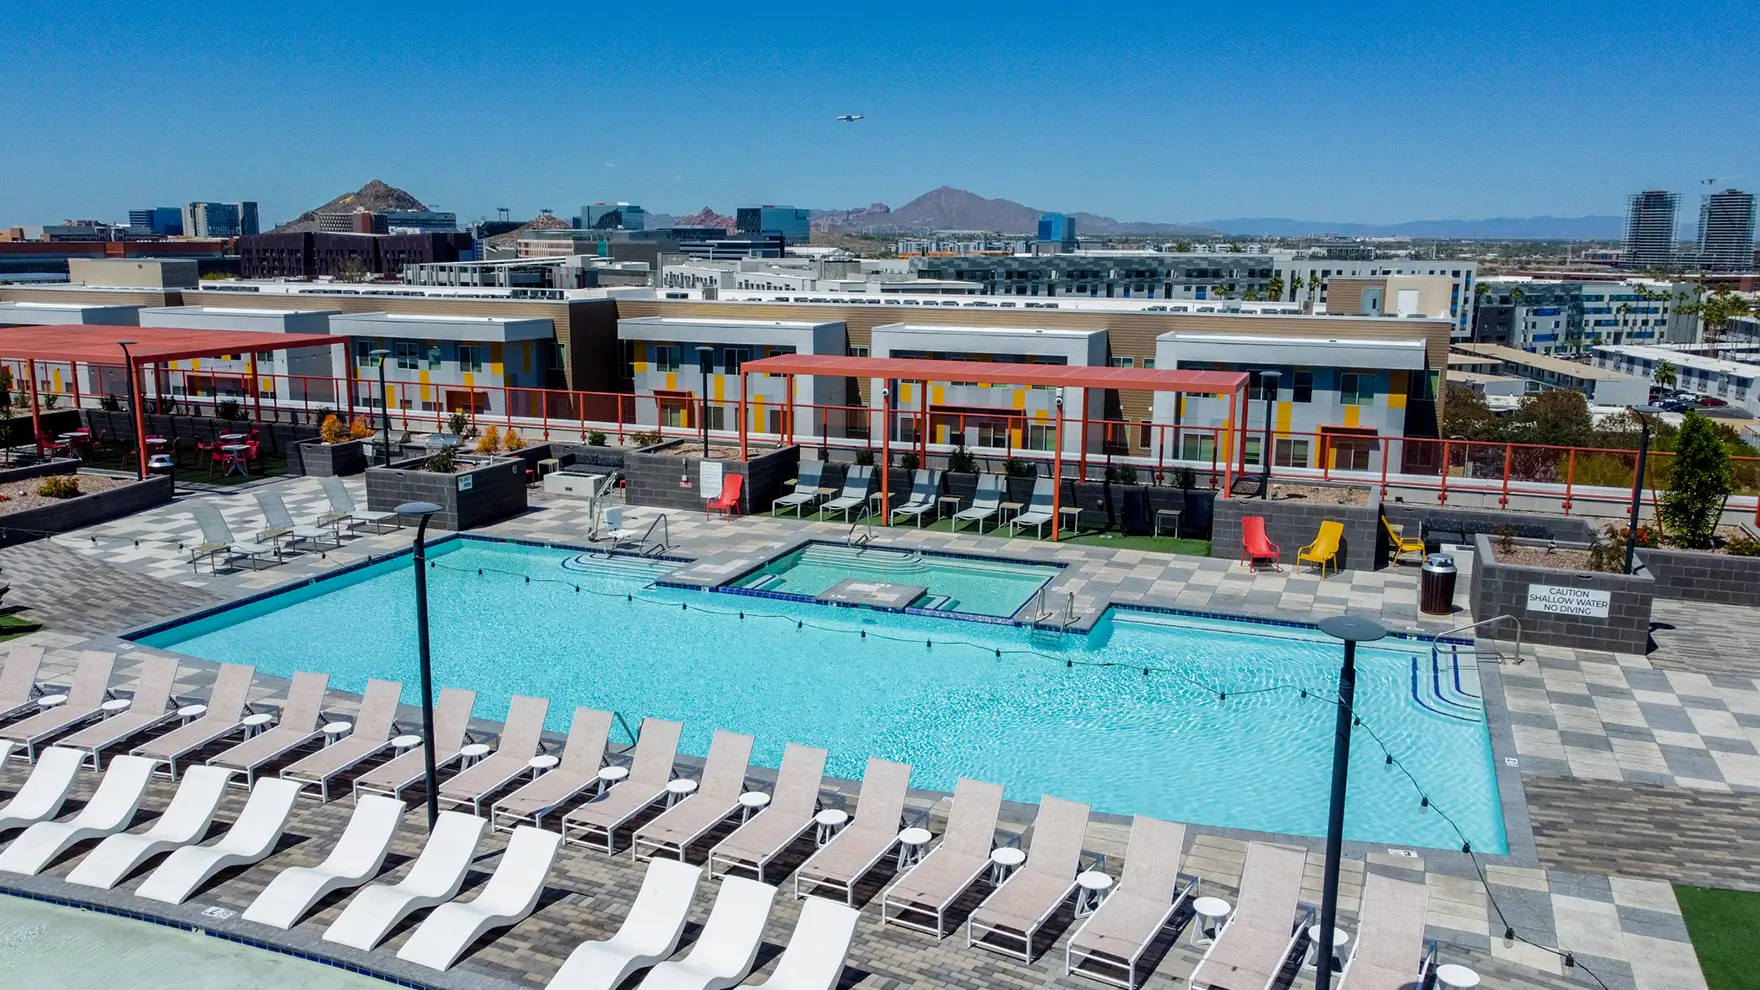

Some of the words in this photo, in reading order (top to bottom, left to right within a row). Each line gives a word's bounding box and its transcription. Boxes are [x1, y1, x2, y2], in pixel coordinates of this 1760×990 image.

[1549, 588, 1589, 598] CAUTION
[1529, 594, 1574, 605] SHALLOW
[1576, 599, 1608, 608] WATER
[1543, 604, 1558, 612] NO
[1560, 605, 1591, 615] DIVING
